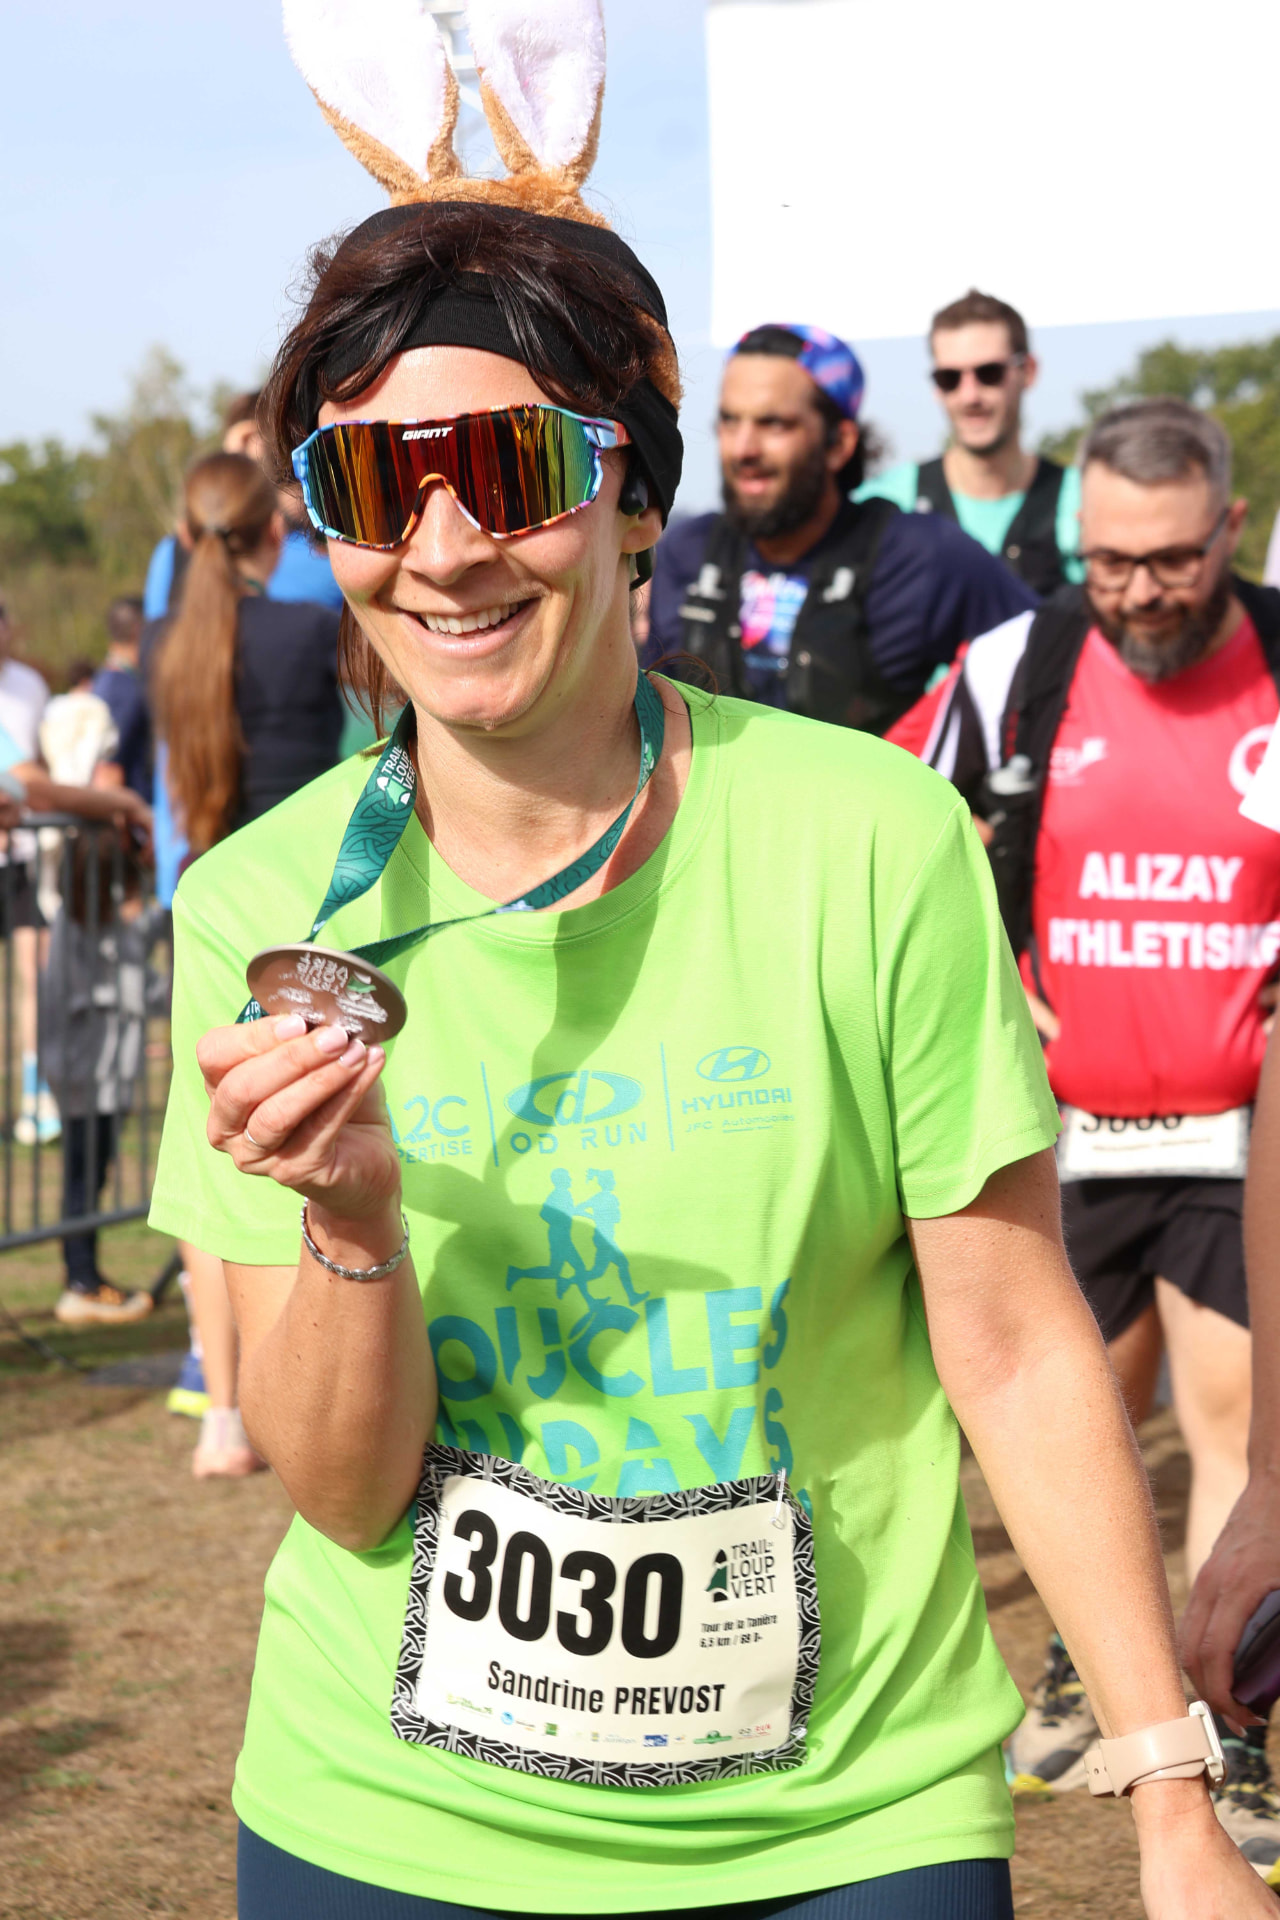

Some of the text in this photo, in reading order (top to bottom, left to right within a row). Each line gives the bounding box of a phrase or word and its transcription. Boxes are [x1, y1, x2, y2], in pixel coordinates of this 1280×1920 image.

[402, 427, 453, 441] GIANT
[381, 746, 403, 775] TRAIL
[391, 750, 410, 784] LOUP
[1078, 851, 1244, 903] ALIZAY
[681, 1087, 793, 1115] HYUNDAI
[386, 1094, 470, 1144] 2C
[397, 1139, 473, 1164] PERTISE
[510, 1121, 648, 1154] OD RUN
[428, 1277, 793, 1402] OUCLES
[731, 1539, 771, 1560] TRAIL
[730, 1556, 775, 1579] LOUP
[443, 1509, 684, 1659] 3030
[731, 1575, 776, 1599] VERT
[487, 1660, 604, 1714] Sandrine
[614, 1684, 725, 1715] PREVOST
